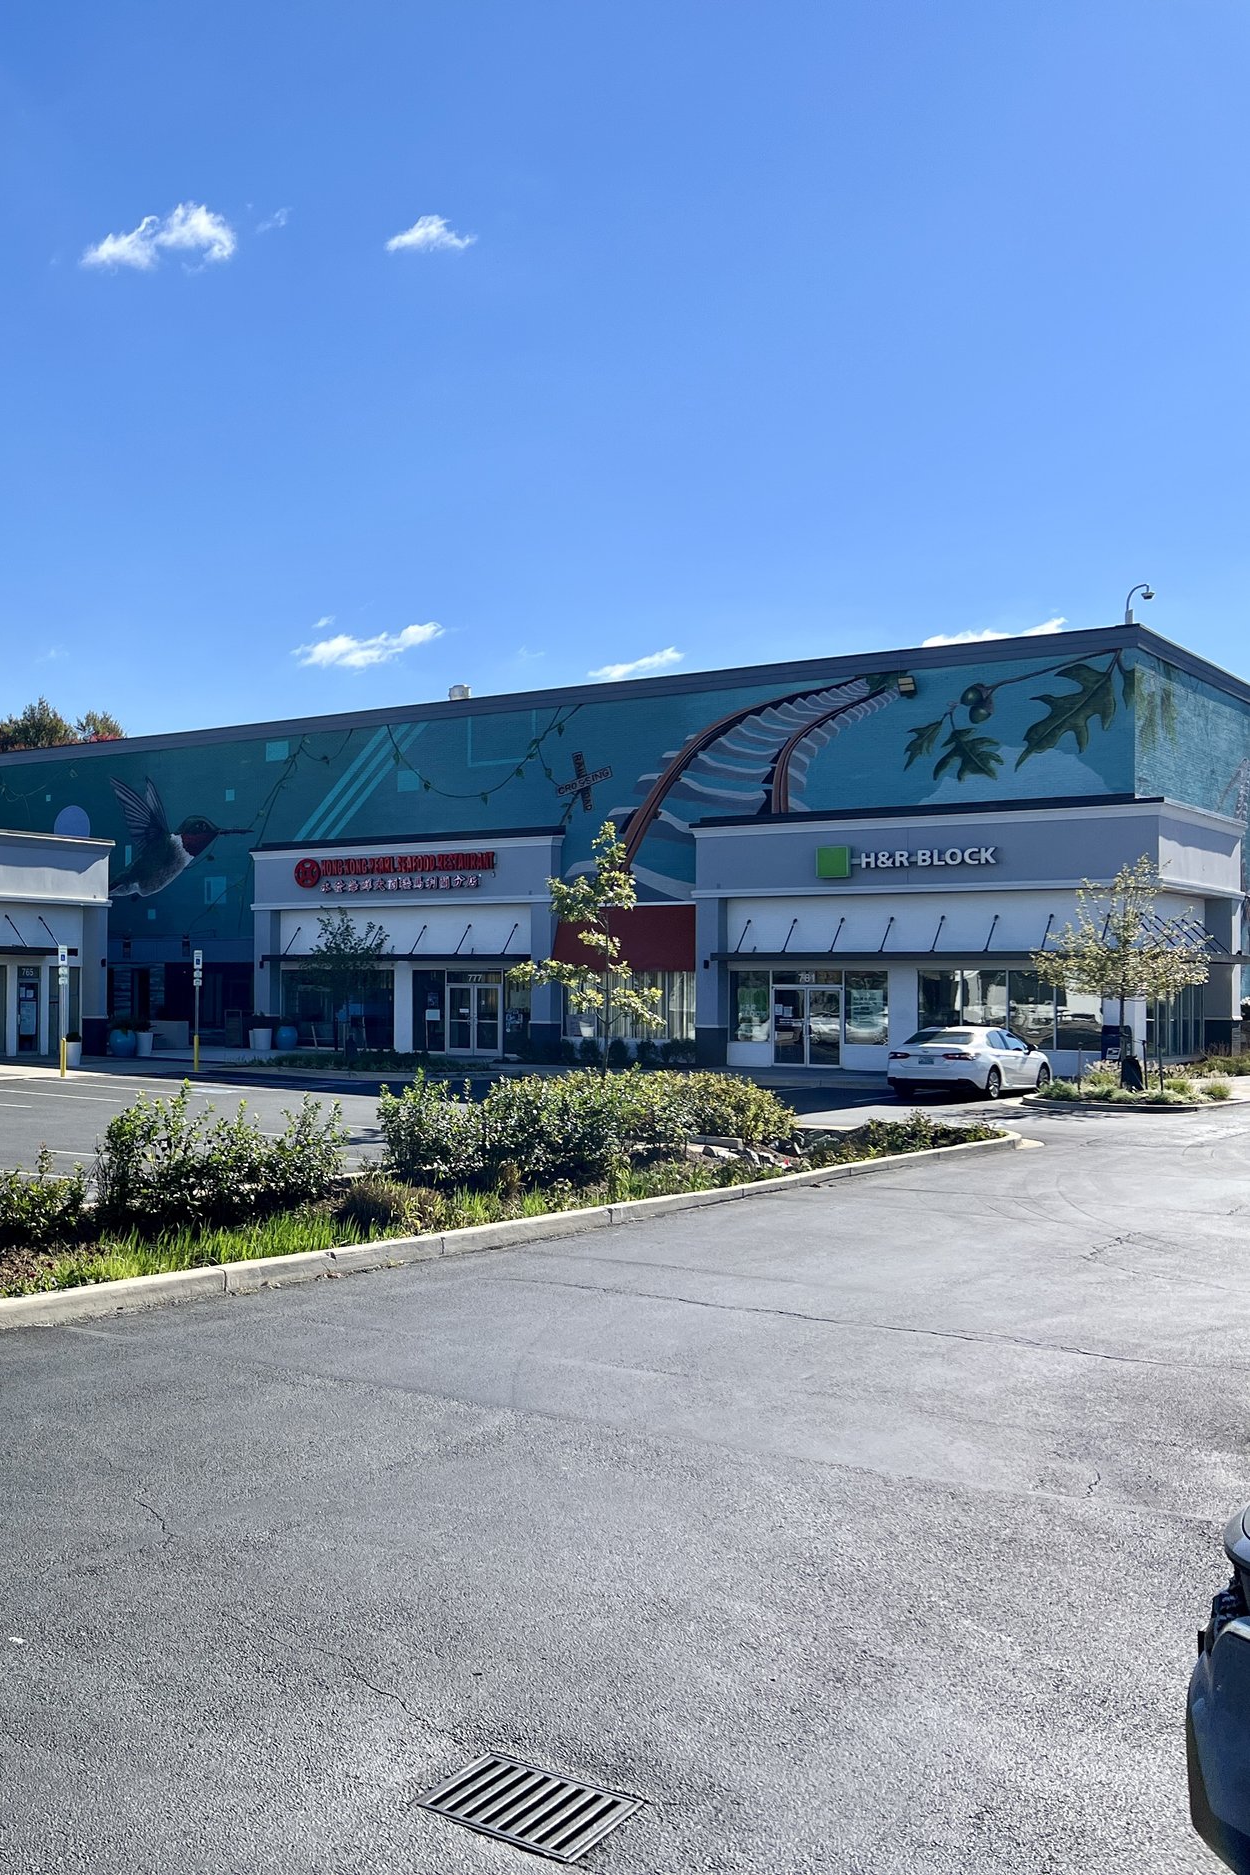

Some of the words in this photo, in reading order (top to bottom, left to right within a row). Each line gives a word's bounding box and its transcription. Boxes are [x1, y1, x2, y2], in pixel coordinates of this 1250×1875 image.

[558, 768, 610, 795] CROSSING
[320, 859, 344, 876] HONG
[344, 858, 367, 875] KONG
[368, 856, 395, 873] PEARL
[397, 855, 436, 873] SEAFOOD
[437, 851, 495, 871] RESTAURANT
[861, 850, 910, 869] H&R
[917, 847, 997, 866] BLOCK
[21, 968, 34, 977] 765
[467, 973, 483, 982] 777
